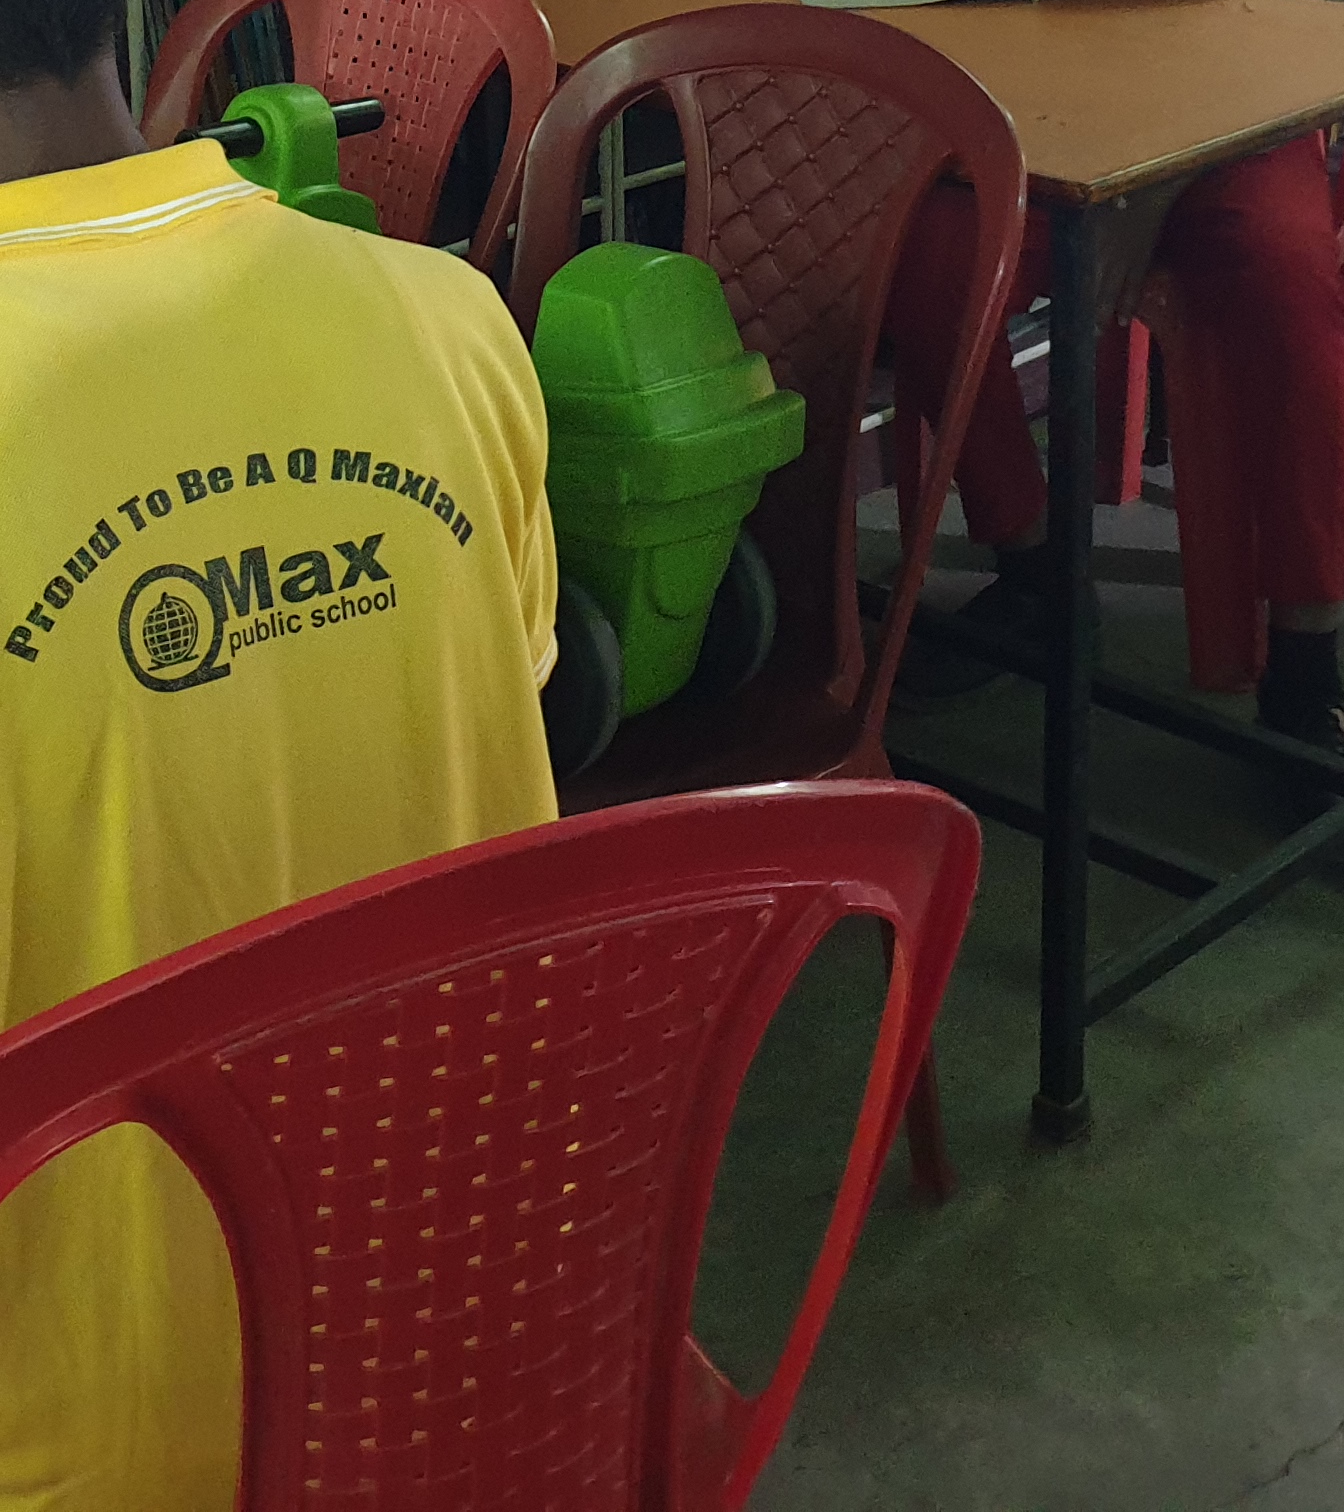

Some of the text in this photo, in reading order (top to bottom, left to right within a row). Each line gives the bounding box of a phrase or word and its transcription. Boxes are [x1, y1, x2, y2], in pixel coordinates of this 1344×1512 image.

[4, 448, 474, 663] Proud To Be A Q Maxian
[228, 584, 398, 657] public school
